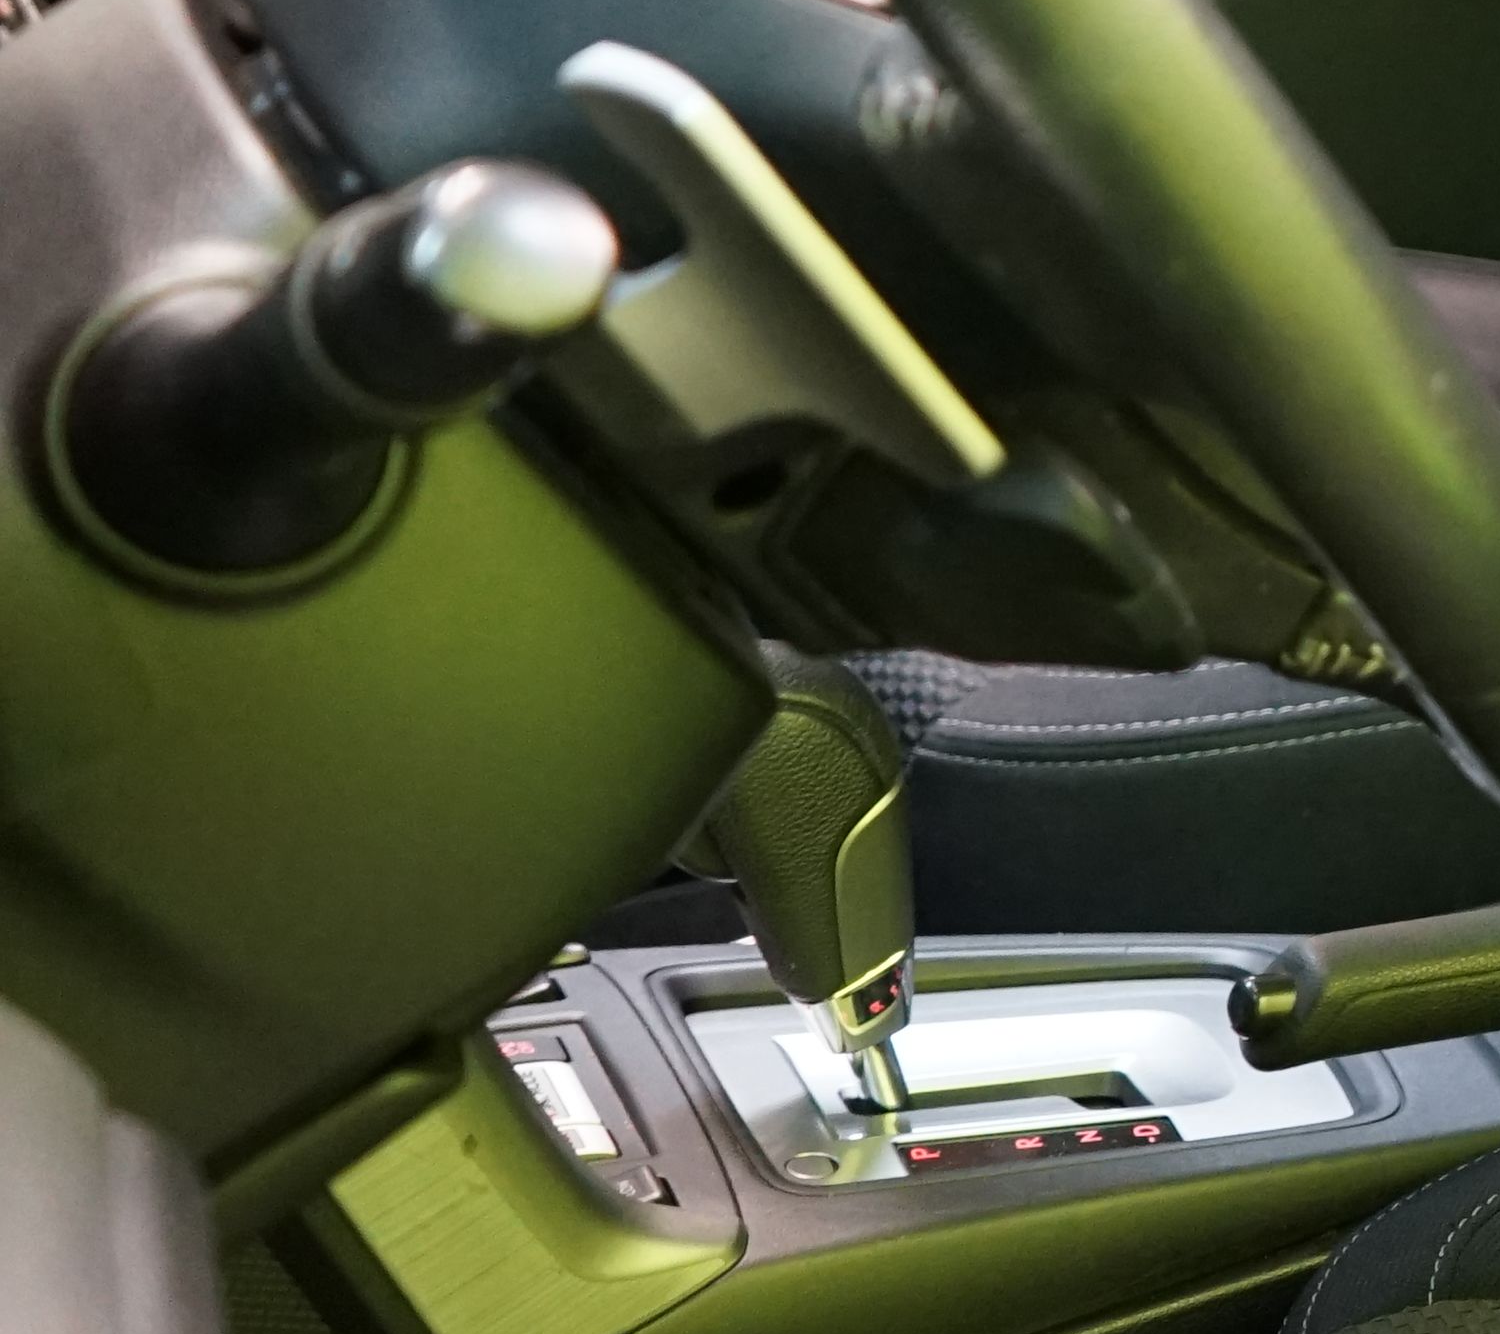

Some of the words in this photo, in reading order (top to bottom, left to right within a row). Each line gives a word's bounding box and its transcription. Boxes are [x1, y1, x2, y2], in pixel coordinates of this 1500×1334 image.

[1015, 1135, 1044, 1150] R
[1075, 1129, 1103, 1144] N
[910, 1146, 941, 1162] P
